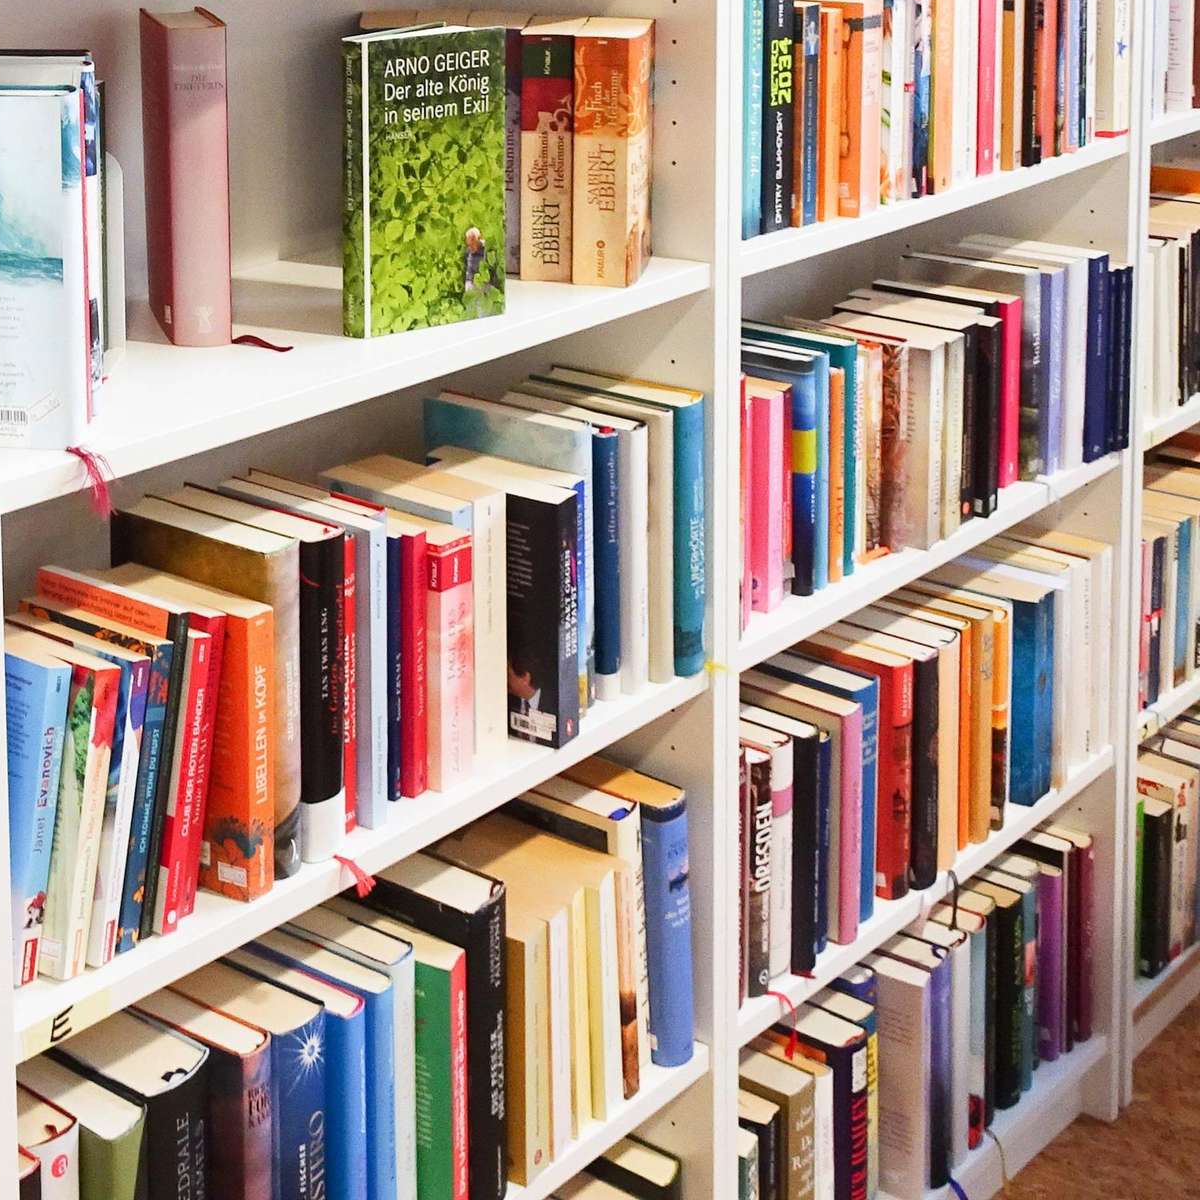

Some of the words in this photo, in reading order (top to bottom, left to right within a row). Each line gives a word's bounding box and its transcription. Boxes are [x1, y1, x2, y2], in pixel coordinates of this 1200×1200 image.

[384, 56, 430, 78] ARNO
[434, 49, 490, 73] GEIGER
[769, 38, 780, 107] METRO
[778, 37, 793, 104] 2034
[384, 109, 398, 124] in
[403, 103, 457, 122] seinem
[463, 96, 490, 114] Exil
[385, 83, 410, 101] Der
[416, 79, 444, 96] alte
[448, 74, 490, 94] König
[386, 131, 412, 141] HANSER
[587, 151, 602, 205] SABINE
[599, 144, 617, 212] EBERT
[531, 205, 546, 256] SABINE
[542, 198, 560, 265] EBERT
[253, 664, 267, 709] KOPF
[191, 687, 204, 736] BÄNDER
[37, 726, 56, 808] Evanovich
[187, 736, 200, 778] ROTEN
[256, 728, 269, 804] LIBELLEN
[184, 780, 195, 803] DER
[33, 817, 47, 853] Janet
[181, 805, 192, 837] CLUB
[754, 801, 773, 895] DRESDEN
[50, 1004, 72, 1046] E
